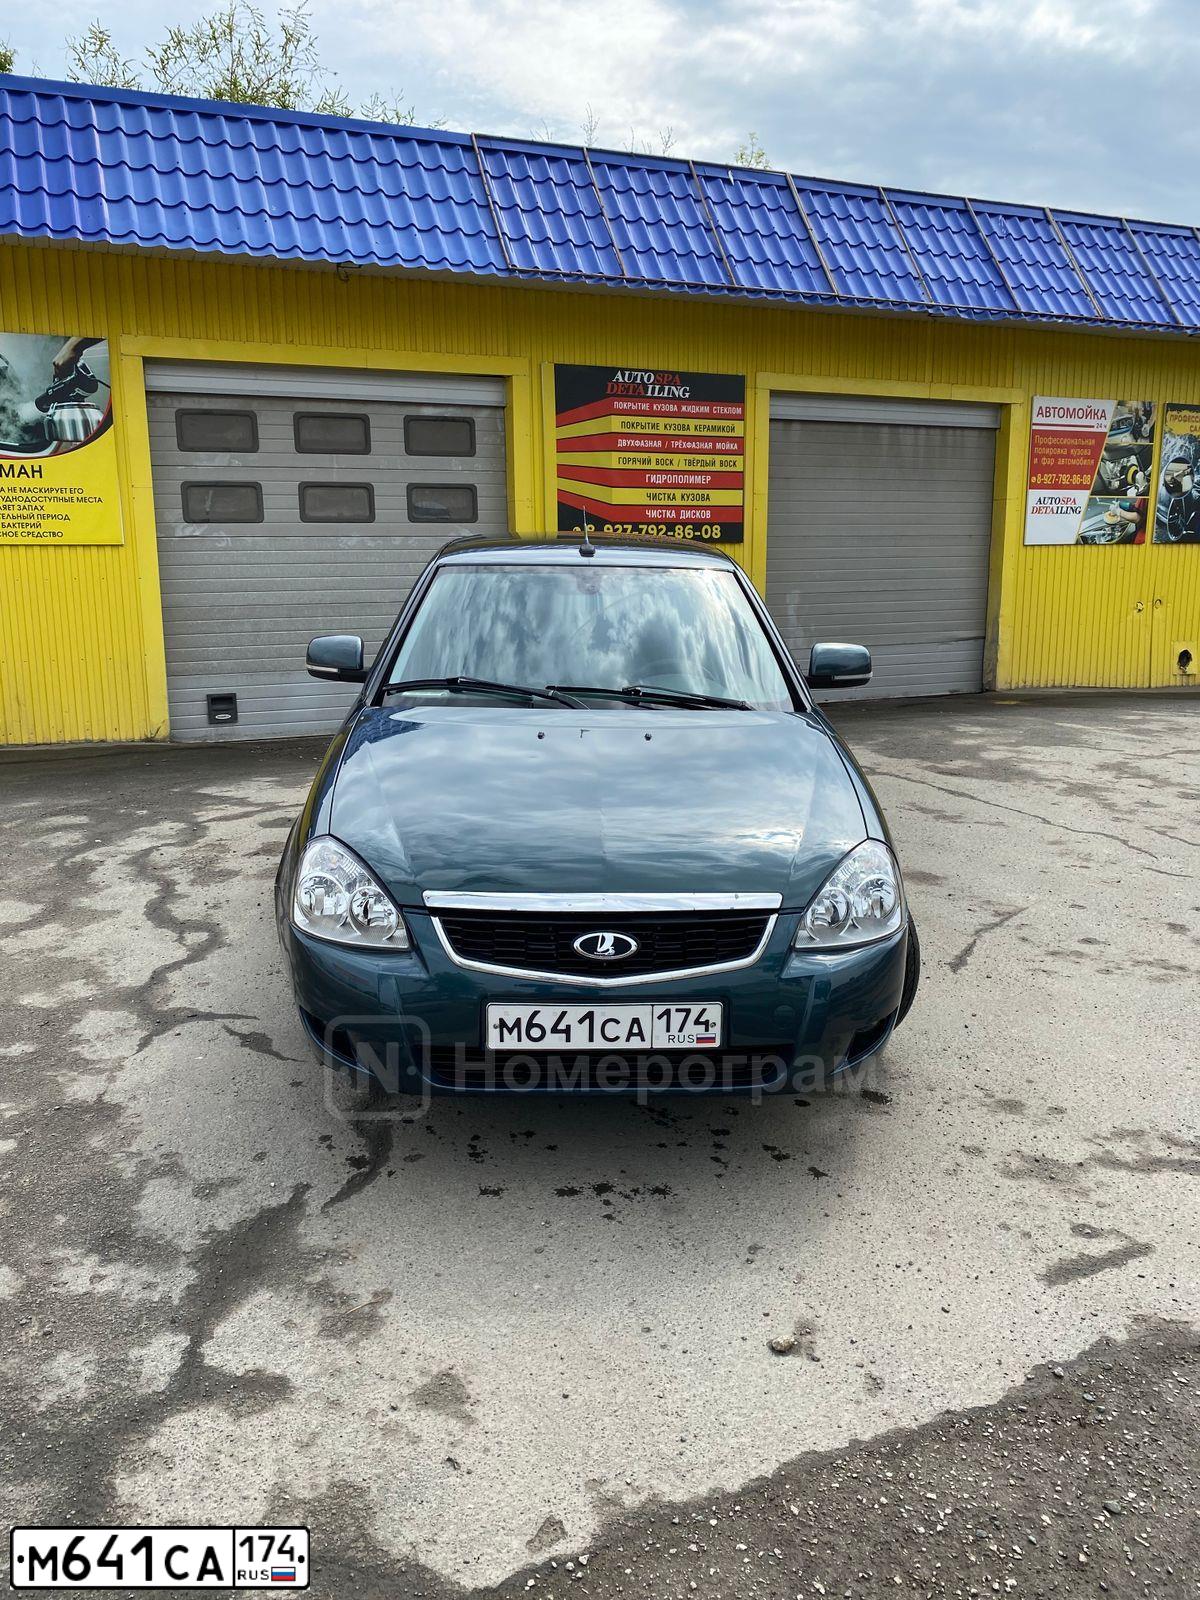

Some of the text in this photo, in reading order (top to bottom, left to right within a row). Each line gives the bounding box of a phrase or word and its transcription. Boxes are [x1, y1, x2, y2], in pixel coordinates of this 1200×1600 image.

[612, 370, 682, 386] AUTOSPA
[605, 382, 691, 399] DETAILING
[613, 401, 742, 415] ПОКРЫТИЕ КУЗОВА ЖИДКИМ СТЕКЛОМ
[1036, 405, 1107, 421] АВТОМОЙКА
[1169, 414, 1200, 424] ПРОФЕСС
[620, 420, 736, 434] ПОКРЫТИЕ КУЗОВА КЕРАМИКОЙ
[617, 438, 662, 448] ДВУХФАЗНАЯ
[670, 438, 713, 450] ТРЁХФАЗНАЯ
[716, 440, 738, 450] МОЙКА
[1034, 434, 1095, 446] Профессиональная
[1034, 447, 1068, 457] полировка
[618, 455, 652, 466] ГОРЯЧИЙ
[655, 457, 674, 467] ВОСК
[683, 456, 716, 468] ТВЁРДЫЙ
[719, 459, 738, 468] ВОСК
[1041, 456, 1055, 467] фар
[0, 463, 43, 479] МАН
[645, 473, 712, 485] ГИДРОПОЛИМЕР
[1036, 473, 1092, 485] 8-927-792-86-08
[7, 486, 18, 494] НЕ
[19, 486, 68, 495] МАСКИРУЕТ
[69, 487, 84, 495] ЕГО
[76, 496, 104, 504] МЕСТА
[646, 491, 711, 502] ЧИСТКА КУЗОВА
[1035, 496, 1077, 505] AUTOSPA
[645, 509, 712, 520] ЧИСТКА ДИСКОВ
[1031, 505, 1082, 515] DETAILING
[36, 512, 71, 521] ПЕРИОД
[1, 520, 42, 529] БАКТЕРИЙ
[20, 530, 64, 538] СРЕДСТВО
[587, 524, 721, 539] 8927-792-86-08
[498, 1007, 710, 1043] М641СА 174
[667, 1034, 696, 1044] RUS
